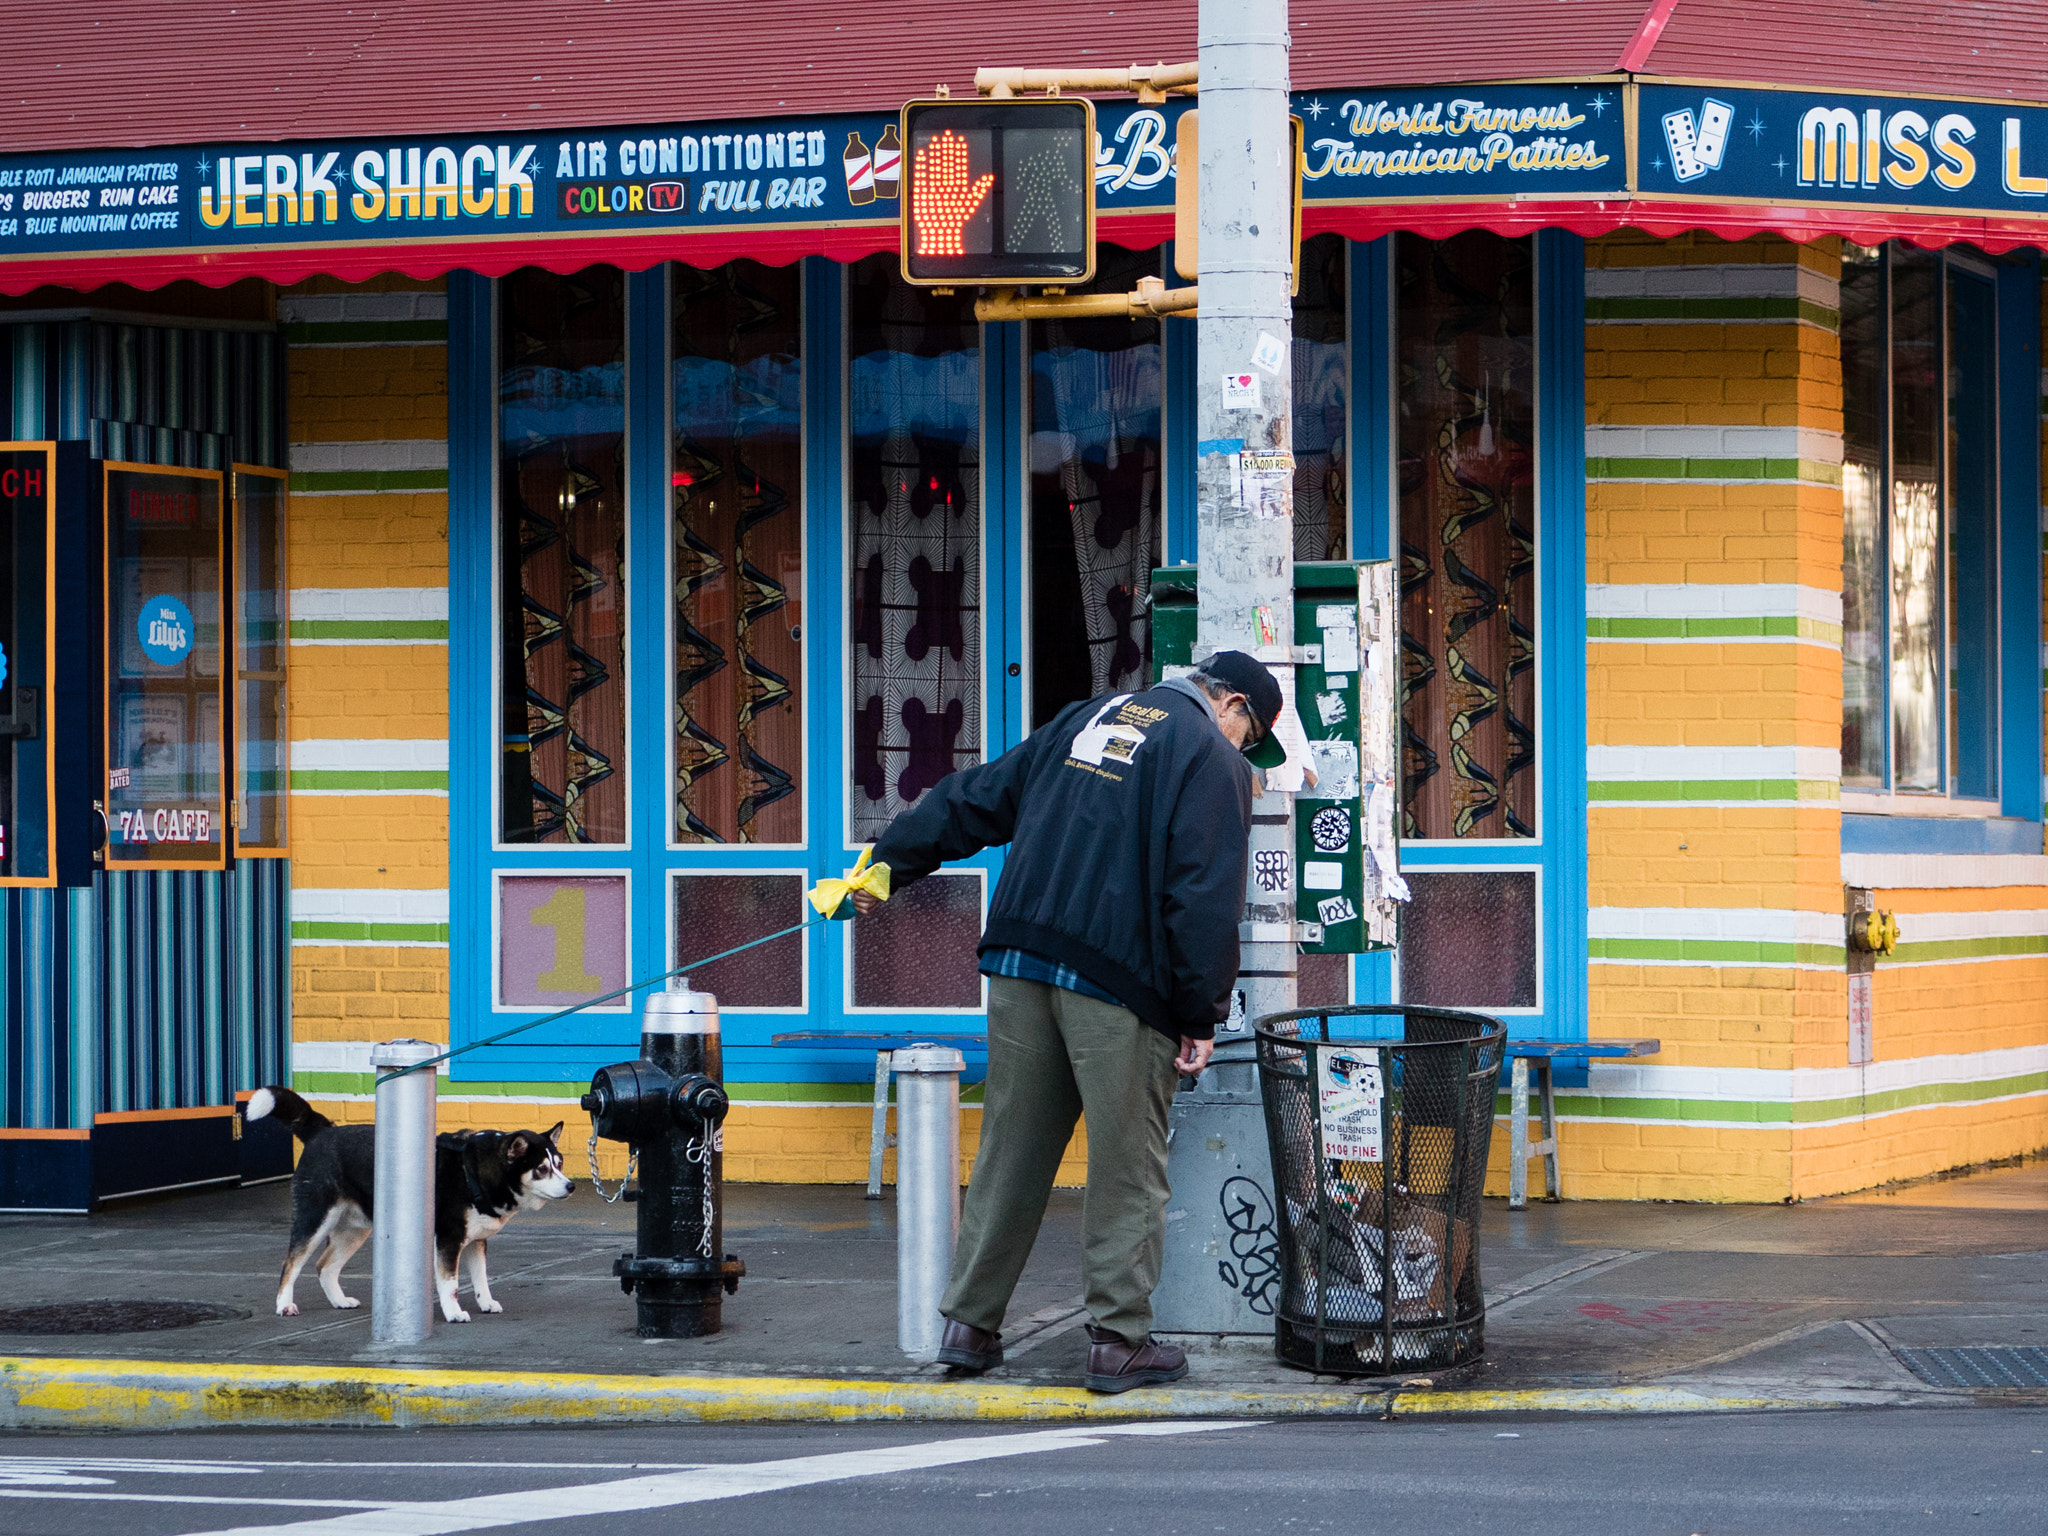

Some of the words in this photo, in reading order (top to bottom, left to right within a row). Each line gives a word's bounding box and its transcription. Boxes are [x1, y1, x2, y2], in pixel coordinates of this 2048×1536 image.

[1340, 99, 1445, 136] World
[1446, 98, 1585, 136] Famous
[556, 140, 607, 177] AIR
[619, 130, 827, 176] CONDITIONED
[1301, 138, 1484, 180] Jamaican
[1480, 132, 1609, 172] Patties
[1797, 106, 1976, 191] MISS
[24, 167, 55, 186] ROTI
[57, 165, 125, 186] JAMAICAN
[126, 162, 179, 182] PATTIES
[199, 152, 340, 228] JERK
[351, 144, 537, 222] SHACK
[22, 189, 91, 211] BURGERS
[99, 187, 135, 207] RUM
[138, 185, 179, 206] CAKE
[565, 185, 644, 214] COLOR
[651, 186, 680, 208] TV
[699, 180, 762, 213] FULL
[765, 177, 828, 210] BAR
[25, 217, 58, 235] BLUE
[60, 213, 128, 234] MOUNTAIN
[130, 211, 180, 231] COFFEE
[129, 489, 198, 523] DINNER
[160, 608, 177, 620] Miss
[148, 620, 187, 652] Lily's
[1121, 700, 1153, 717] Local
[120, 809, 149, 844] 7A
[153, 808, 211, 844] CAFE
[530, 887, 602, 993] 1
[1331, 1058, 1342, 1070] EL
[1324, 1123, 1336, 1132] NO
[1337, 1125, 1378, 1135] BUSINESS
[1339, 1133, 1362, 1143] TRASH
[1352, 1145, 1377, 1158] FINE
